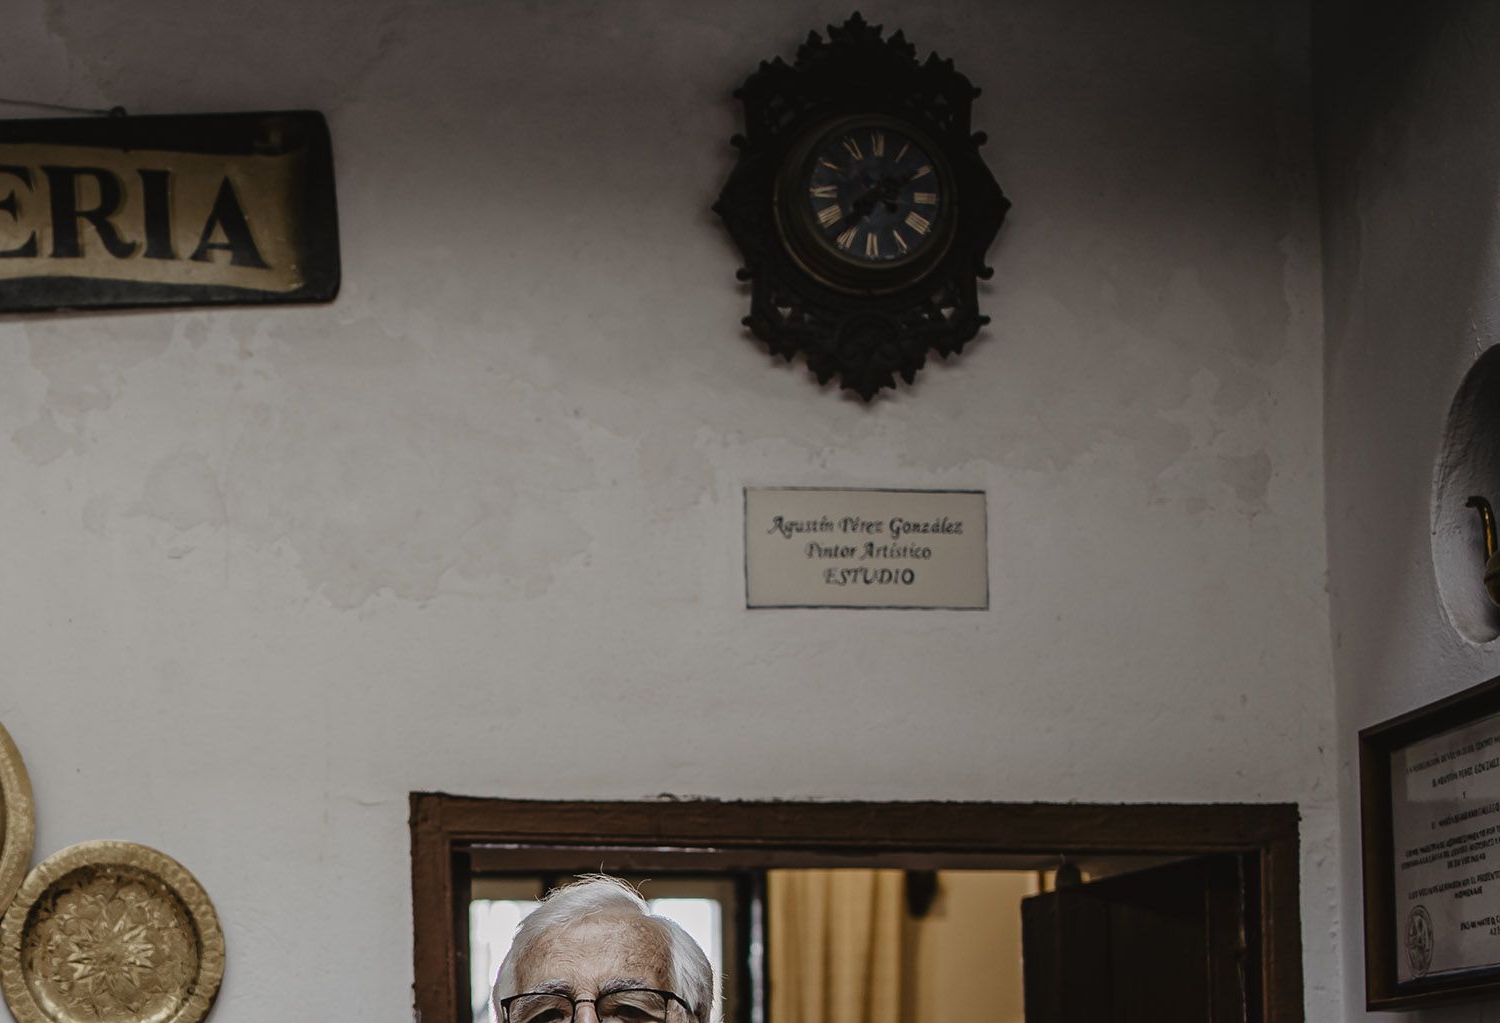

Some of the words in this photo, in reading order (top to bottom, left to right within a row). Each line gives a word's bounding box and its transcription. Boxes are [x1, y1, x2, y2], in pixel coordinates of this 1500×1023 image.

[838, 516, 884, 534] Pérez
[889, 517, 964, 540] González
[805, 541, 857, 560] Pintor
[823, 567, 916, 585] ESTUDIO
